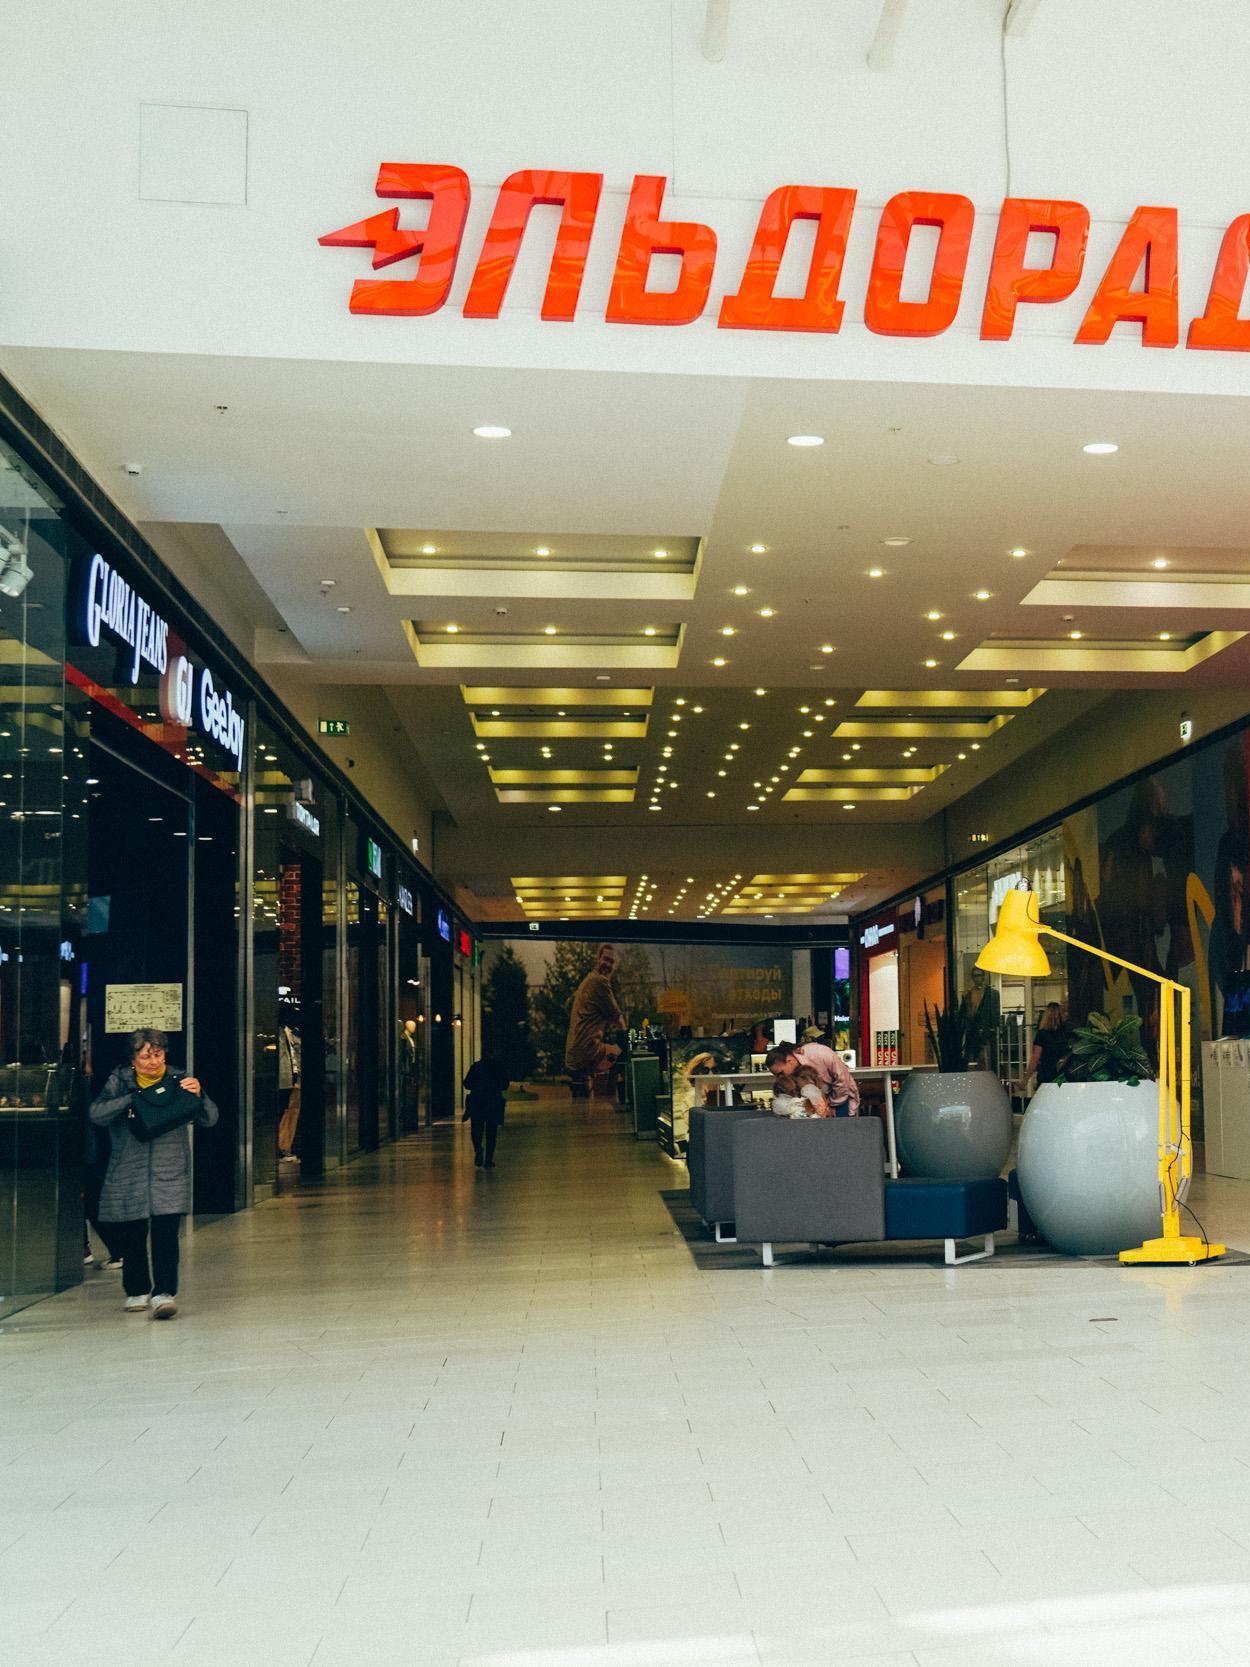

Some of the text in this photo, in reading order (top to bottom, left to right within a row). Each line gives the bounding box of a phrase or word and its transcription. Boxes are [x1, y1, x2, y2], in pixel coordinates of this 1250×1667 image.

[87, 553, 169, 685] GLORIA JEANS
[200, 668, 245, 773] GeeJay
